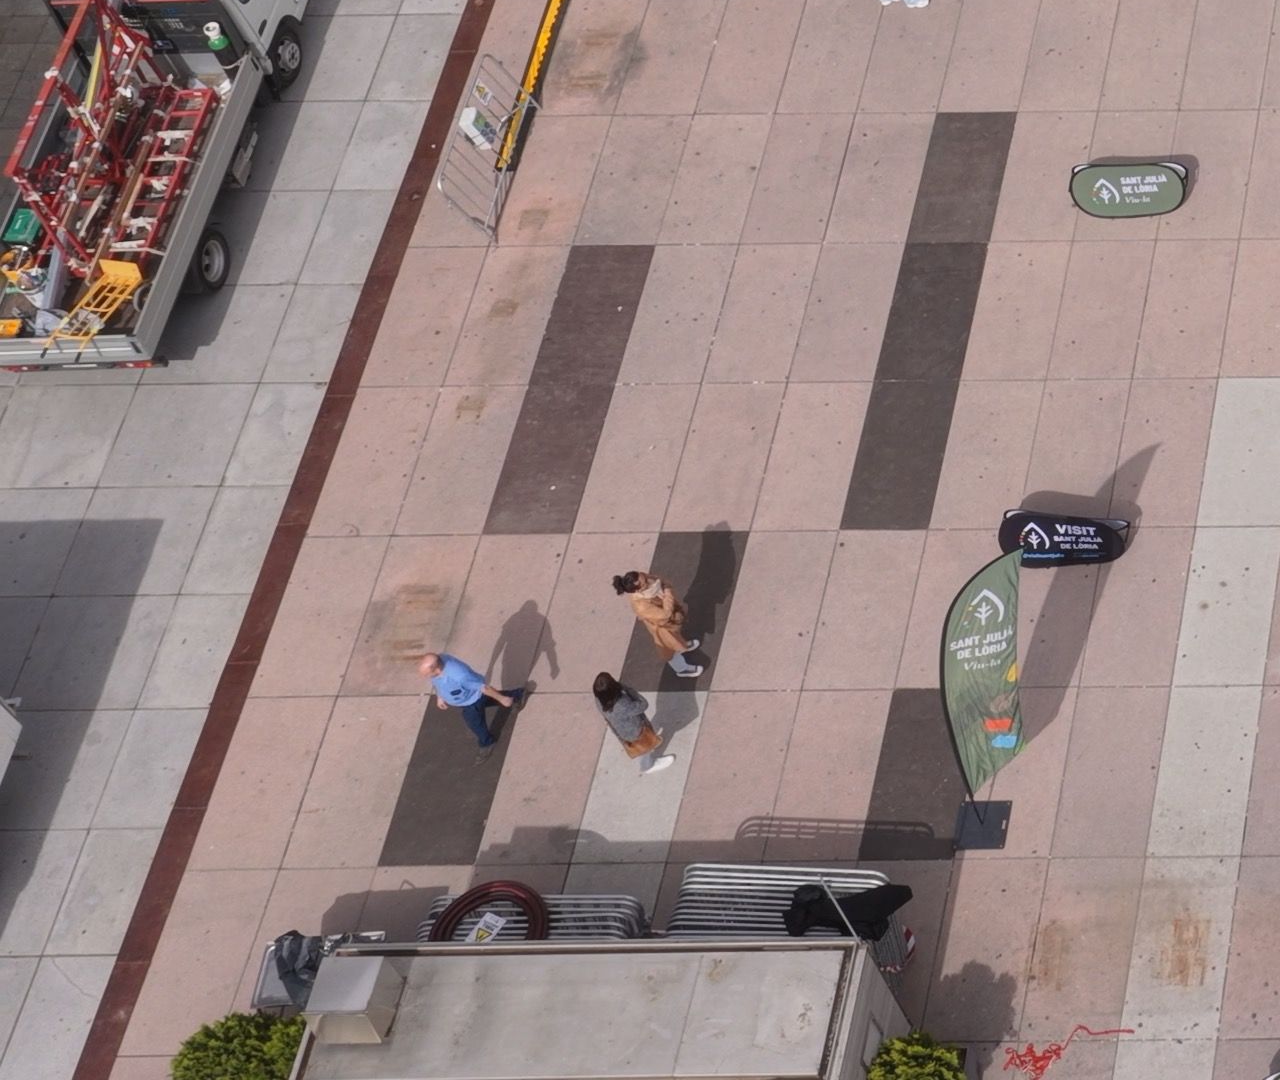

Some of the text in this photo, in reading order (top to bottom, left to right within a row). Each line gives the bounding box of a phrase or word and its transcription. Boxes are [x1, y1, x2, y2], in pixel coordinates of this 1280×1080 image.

[1120, 173, 1168, 185] SANT JULIÀ
[1122, 183, 1159, 194] DE LÒRIA
[1055, 523, 1097, 536] VISIT
[949, 635, 981, 651] SANT
[956, 648, 972, 660] DE
